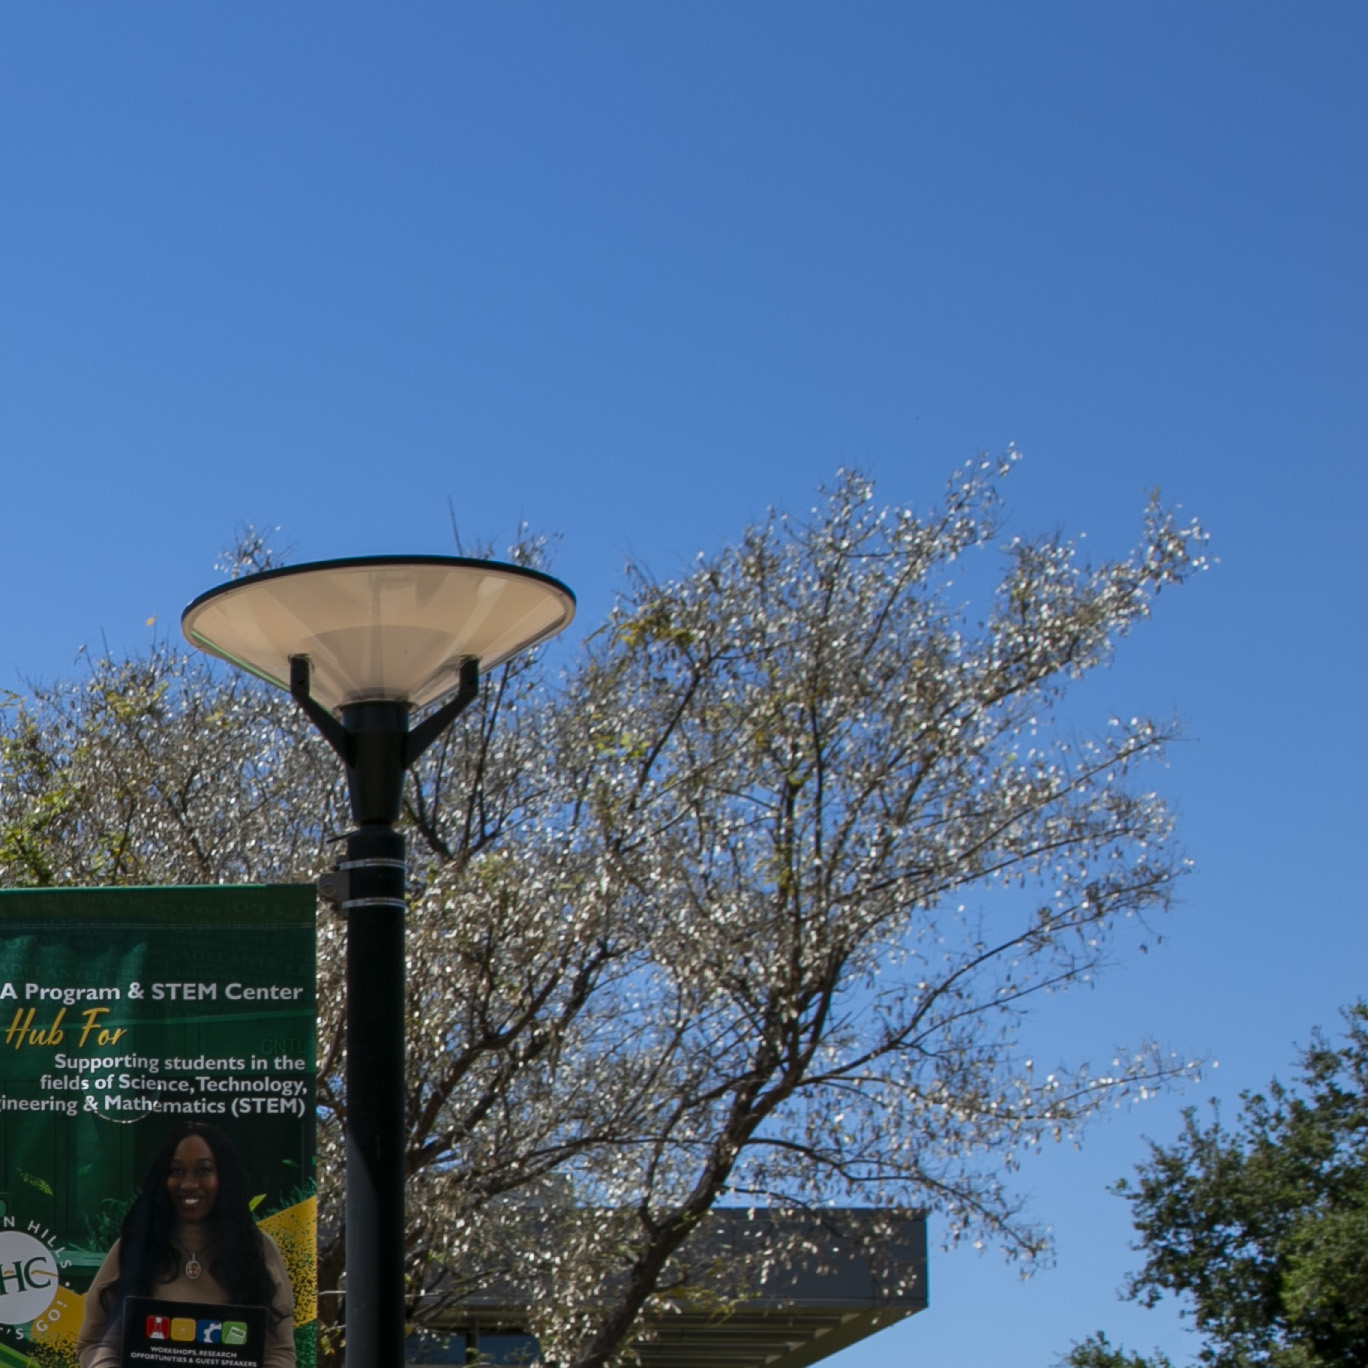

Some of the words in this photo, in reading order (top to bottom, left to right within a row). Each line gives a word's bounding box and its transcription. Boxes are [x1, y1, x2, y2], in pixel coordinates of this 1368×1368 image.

[25, 983, 121, 1005] Program
[128, 982, 145, 1000] &
[152, 983, 217, 1000] STEM
[225, 983, 304, 1001] Center
[5, 1007, 66, 1050] Hub
[78, 1007, 128, 1048] For
[54, 1053, 160, 1075] Supporting
[164, 1055, 245, 1071] students
[251, 1055, 268, 1071] in
[274, 1055, 306, 1072] the
[40, 1074, 89, 1091] fields
[94, 1074, 113, 1091] of
[118, 1074, 195, 1095] Science,
[195, 1075, 308, 1097] Technology,
[83, 1094, 99, 1111] &
[104, 1094, 226, 1114] Mathematics
[231, 1097, 306, 1118] (STEM)
[27, 1220, 73, 1269] HILLS
[35, 1300, 68, 1333] GO!
[130, 1352, 187, 1363] OPPORTUNITIES
[195, 1357, 219, 1365] GUEST
[221, 1359, 258, 1368] SPEAKERS
[150, 1346, 198, 1357] WORKSHOPS,
[199, 1350, 237, 1359] RESEARCH
